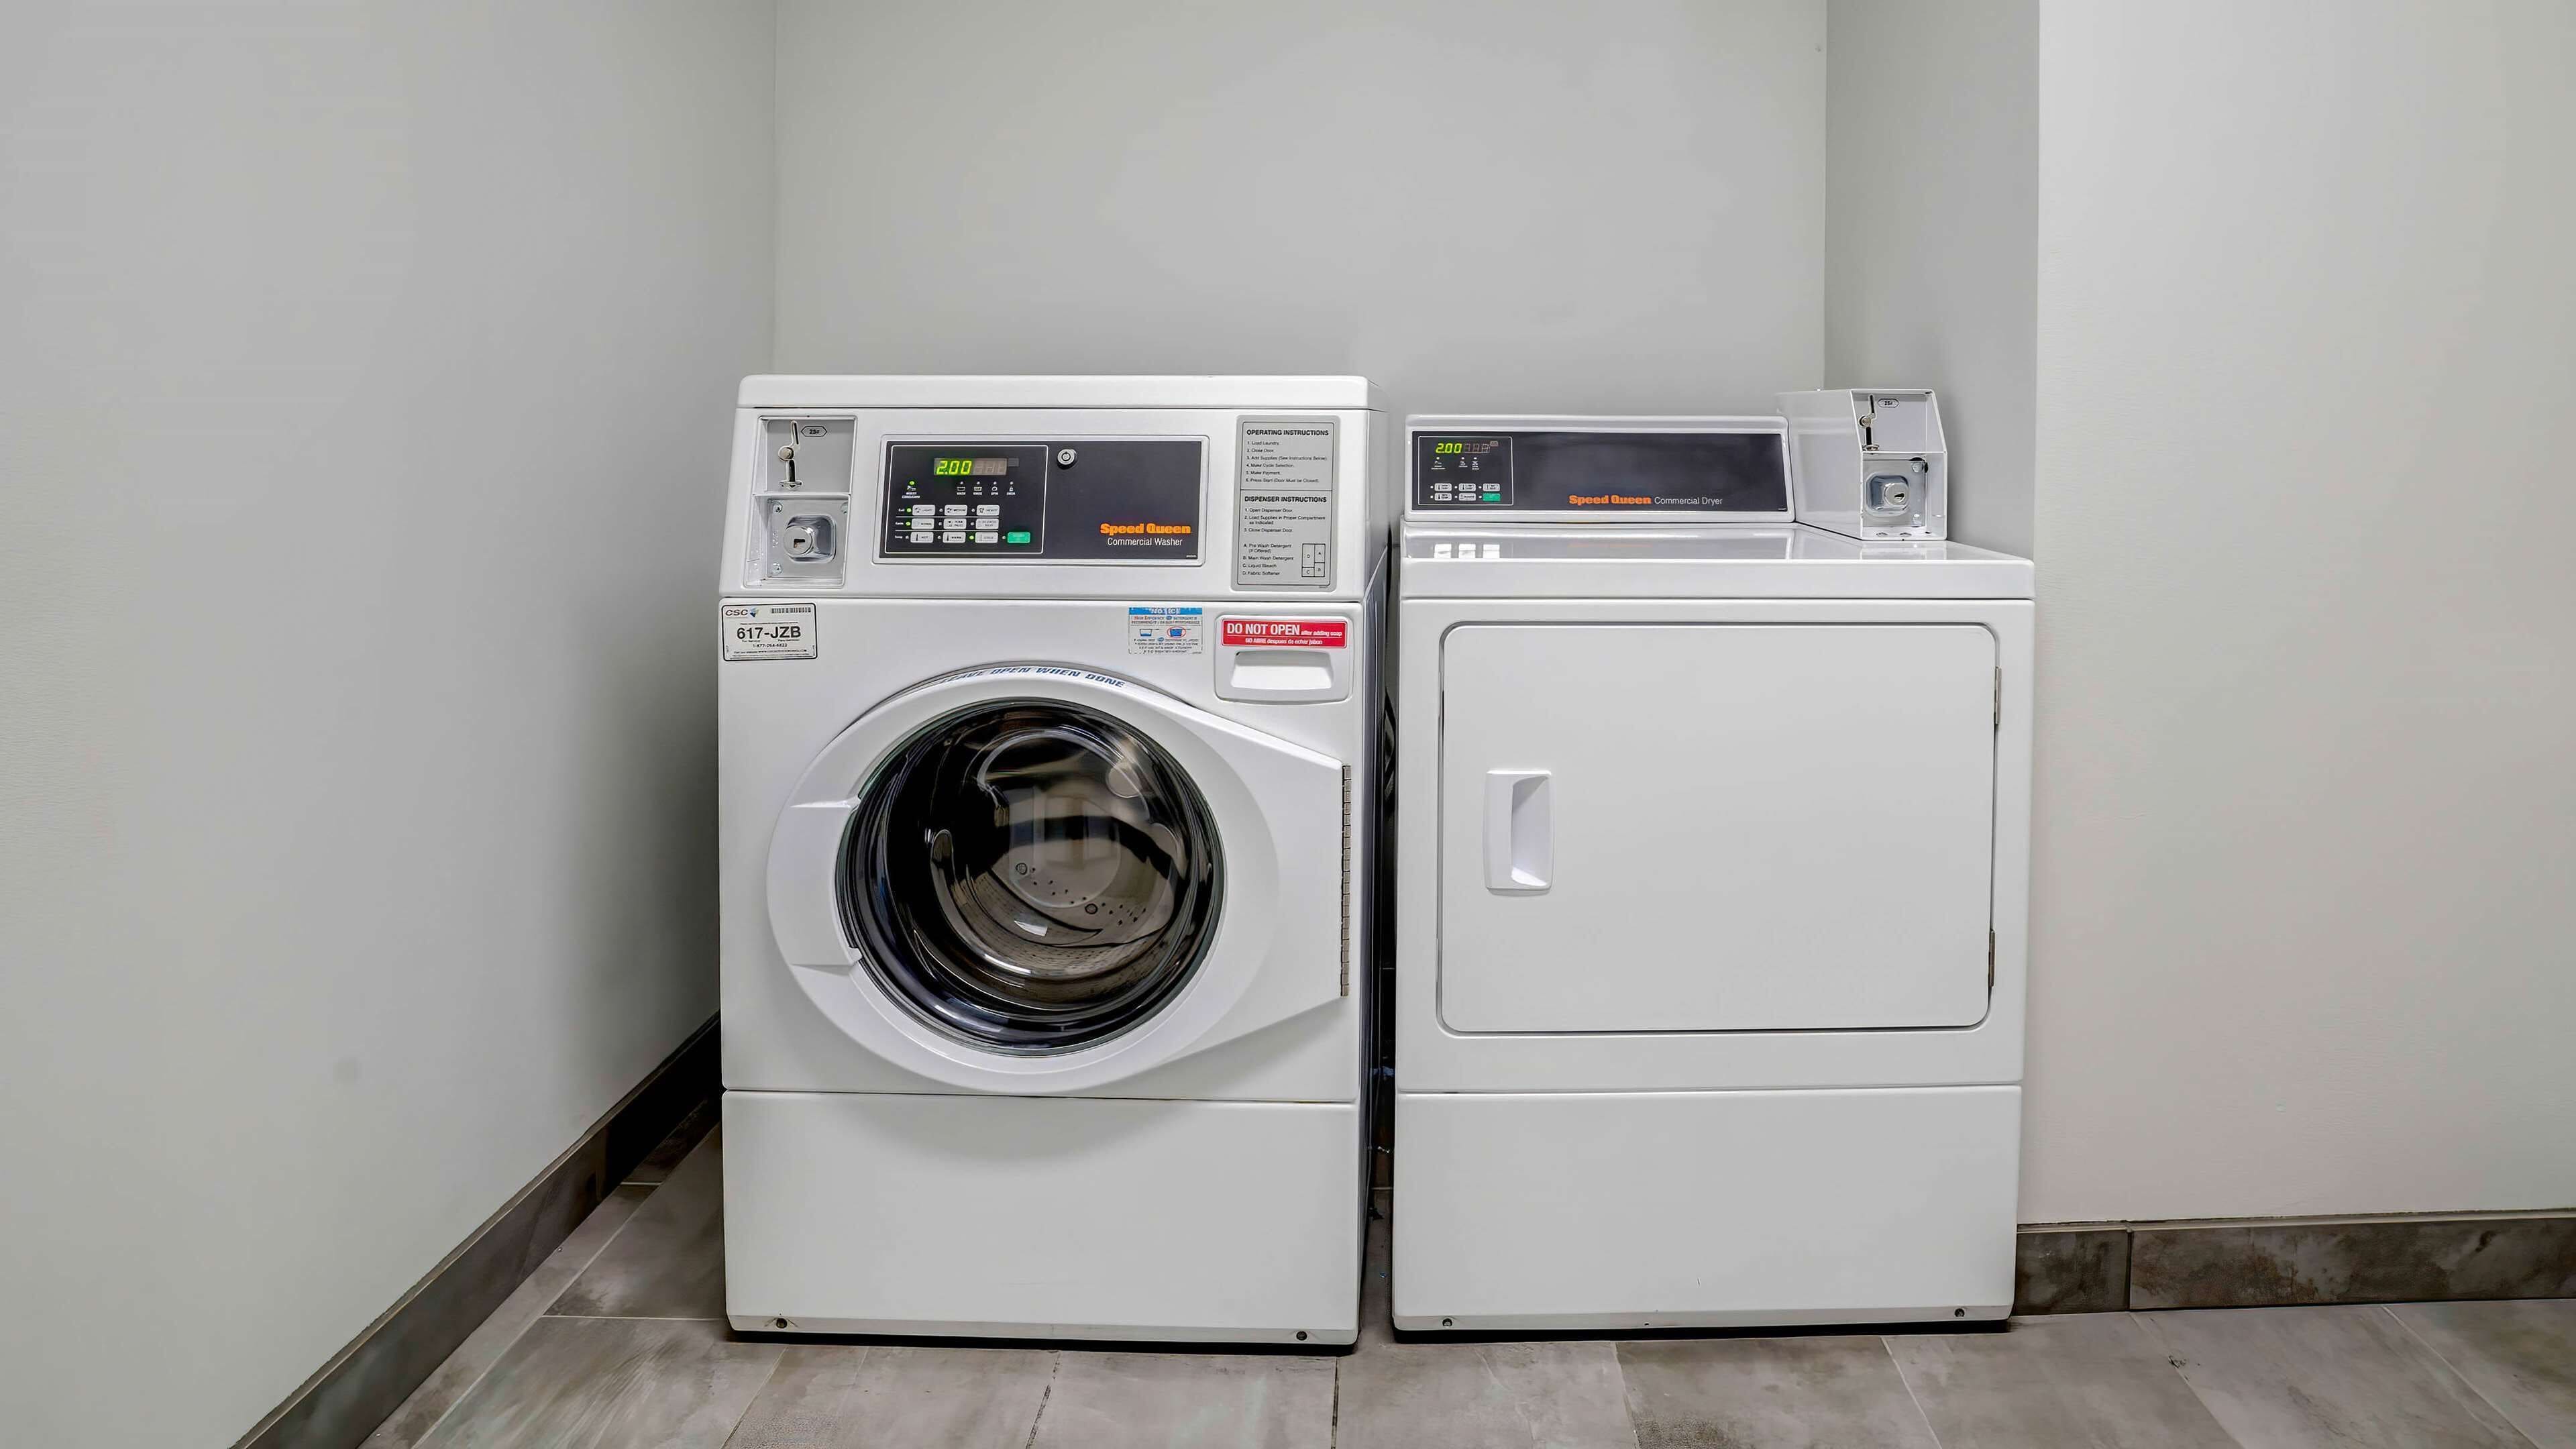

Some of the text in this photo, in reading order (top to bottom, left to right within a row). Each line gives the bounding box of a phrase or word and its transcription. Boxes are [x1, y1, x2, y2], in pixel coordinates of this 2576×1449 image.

[936, 460, 972, 475] 2.00
[1569, 495, 1723, 506] Speed Queen Commercial Dryer
[1100, 523, 1191, 535] Speed Queen
[1108, 537, 1183, 546] Commercial Washer
[737, 626, 801, 639] 617-JZB
[1227, 623, 1242, 634] DO
[1245, 623, 1269, 635] NOT
[1271, 624, 1300, 635] OPEN
[1036, 667, 1080, 677] WHEN
[1085, 673, 1126, 688] DONE
